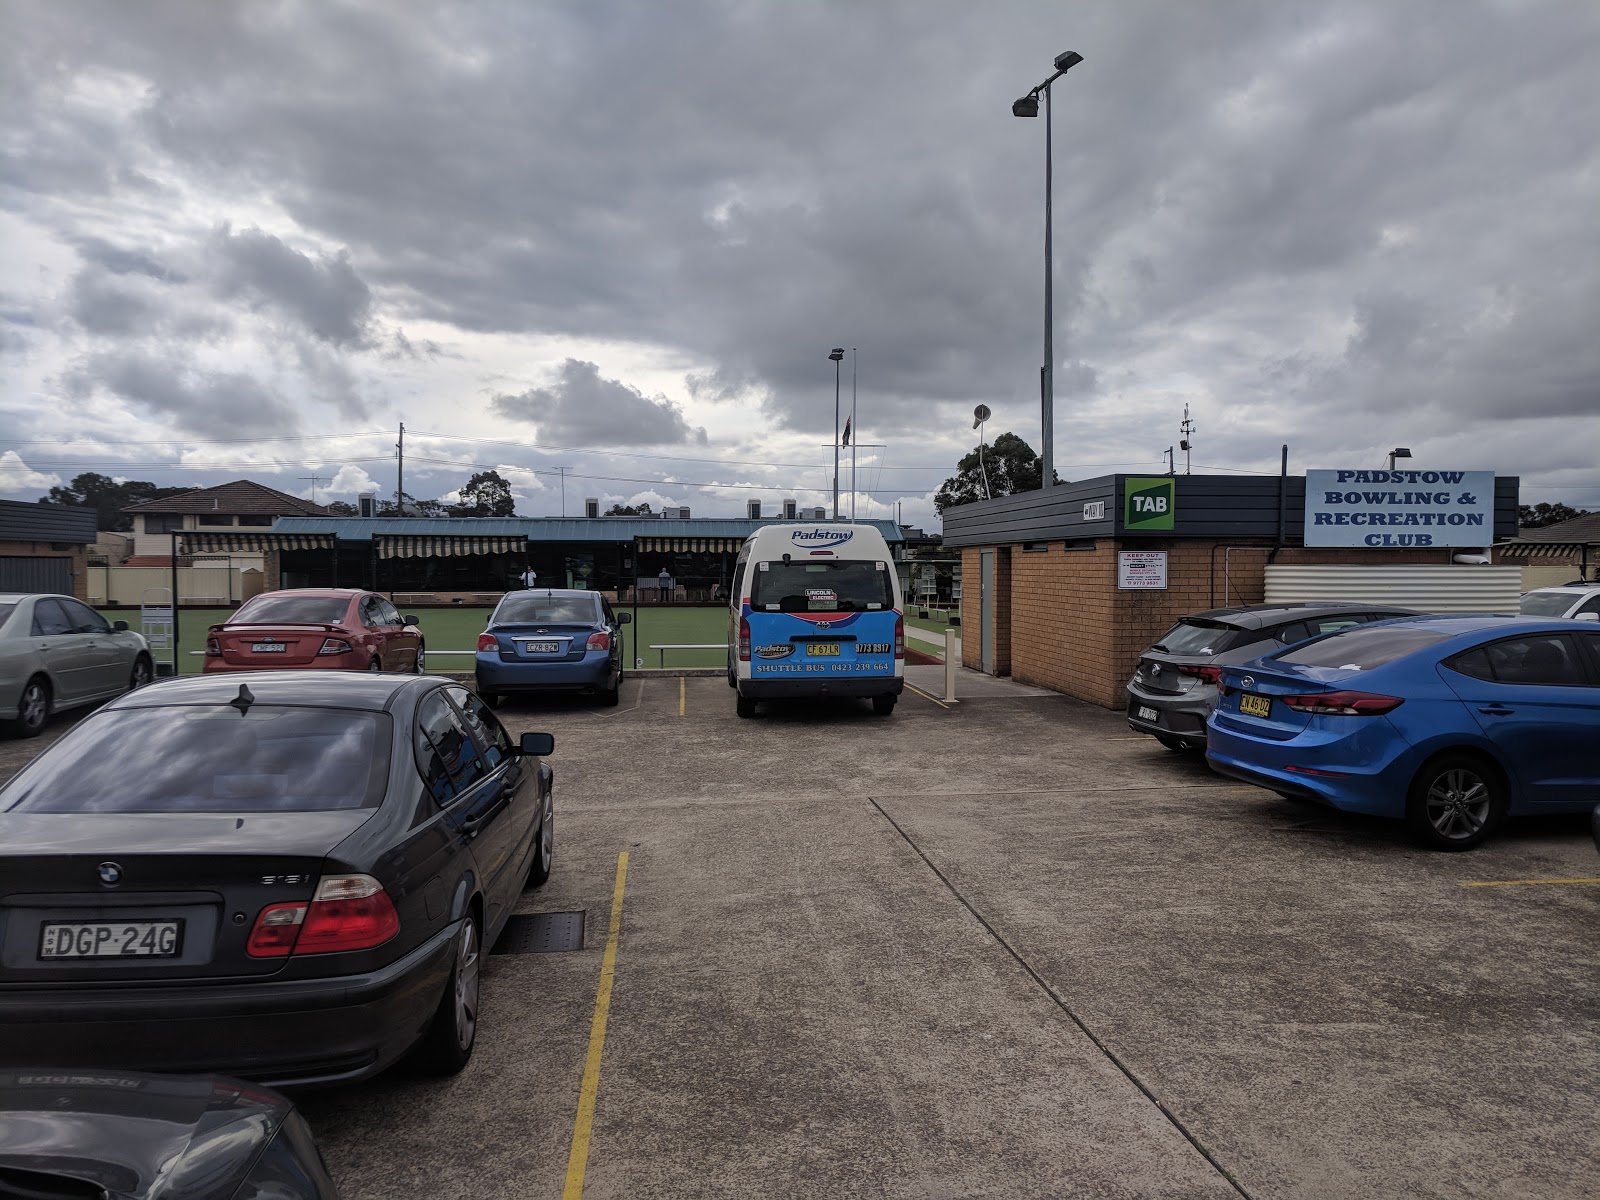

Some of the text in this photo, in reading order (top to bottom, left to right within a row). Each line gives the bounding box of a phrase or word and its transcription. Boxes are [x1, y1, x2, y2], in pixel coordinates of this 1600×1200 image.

[1337, 470, 1465, 484] PADSTOW
[1132, 496, 1167, 512] TAB
[1324, 491, 1477, 505] BOWLING &
[1314, 512, 1484, 526] RECREATION
[791, 528, 850, 540] Padstow
[1364, 533, 1433, 547] CLUB
[855, 643, 889, 653] 9773 8917
[756, 665, 803, 673] SHUTTLE
[806, 664, 825, 672] BUS
[831, 664, 852, 672] 0423
[855, 663, 871, 671] 239
